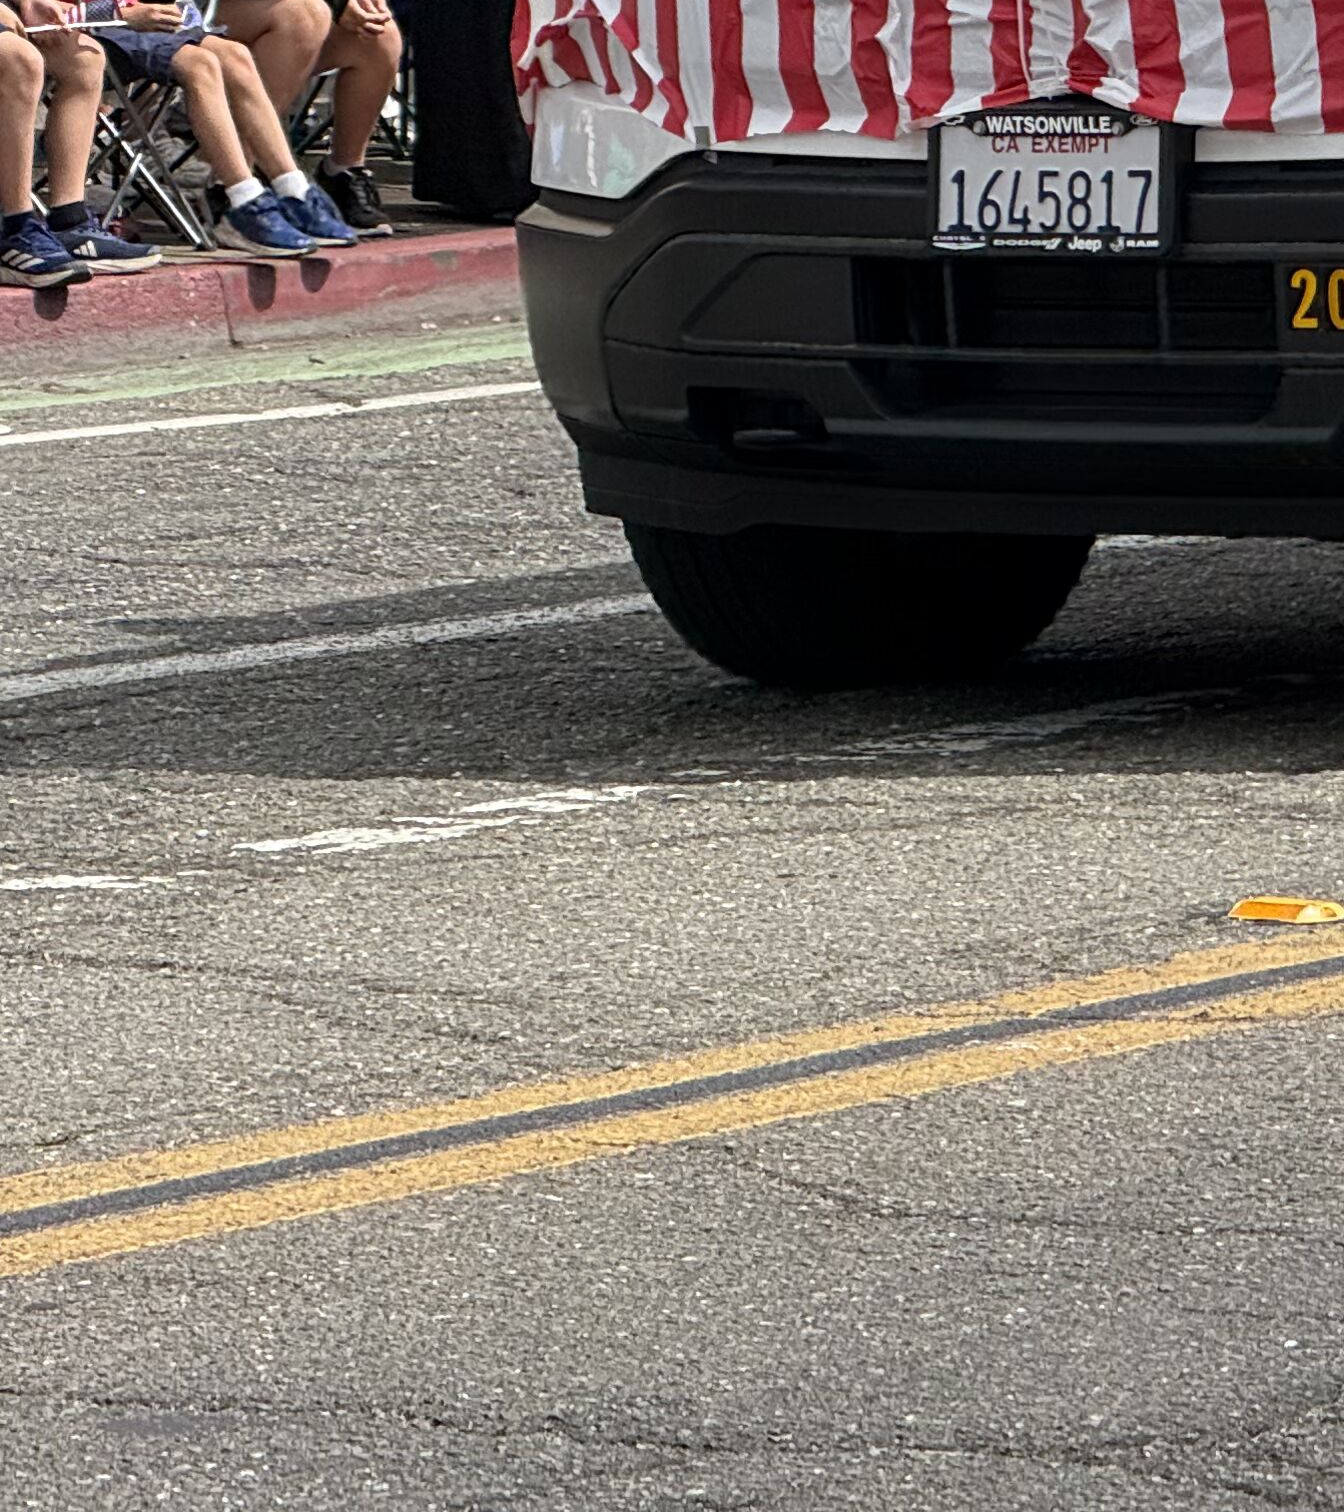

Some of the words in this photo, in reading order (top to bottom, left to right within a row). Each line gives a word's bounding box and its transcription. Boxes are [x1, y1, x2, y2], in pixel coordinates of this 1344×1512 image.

[986, 115, 1112, 134] WATSONVILLE
[991, 137, 1020, 154] CA
[1031, 137, 1111, 154] EXEMPT
[948, 169, 1153, 233] 1645817
[1067, 236, 1102, 253] Jeep
[1126, 239, 1159, 248] RAM
